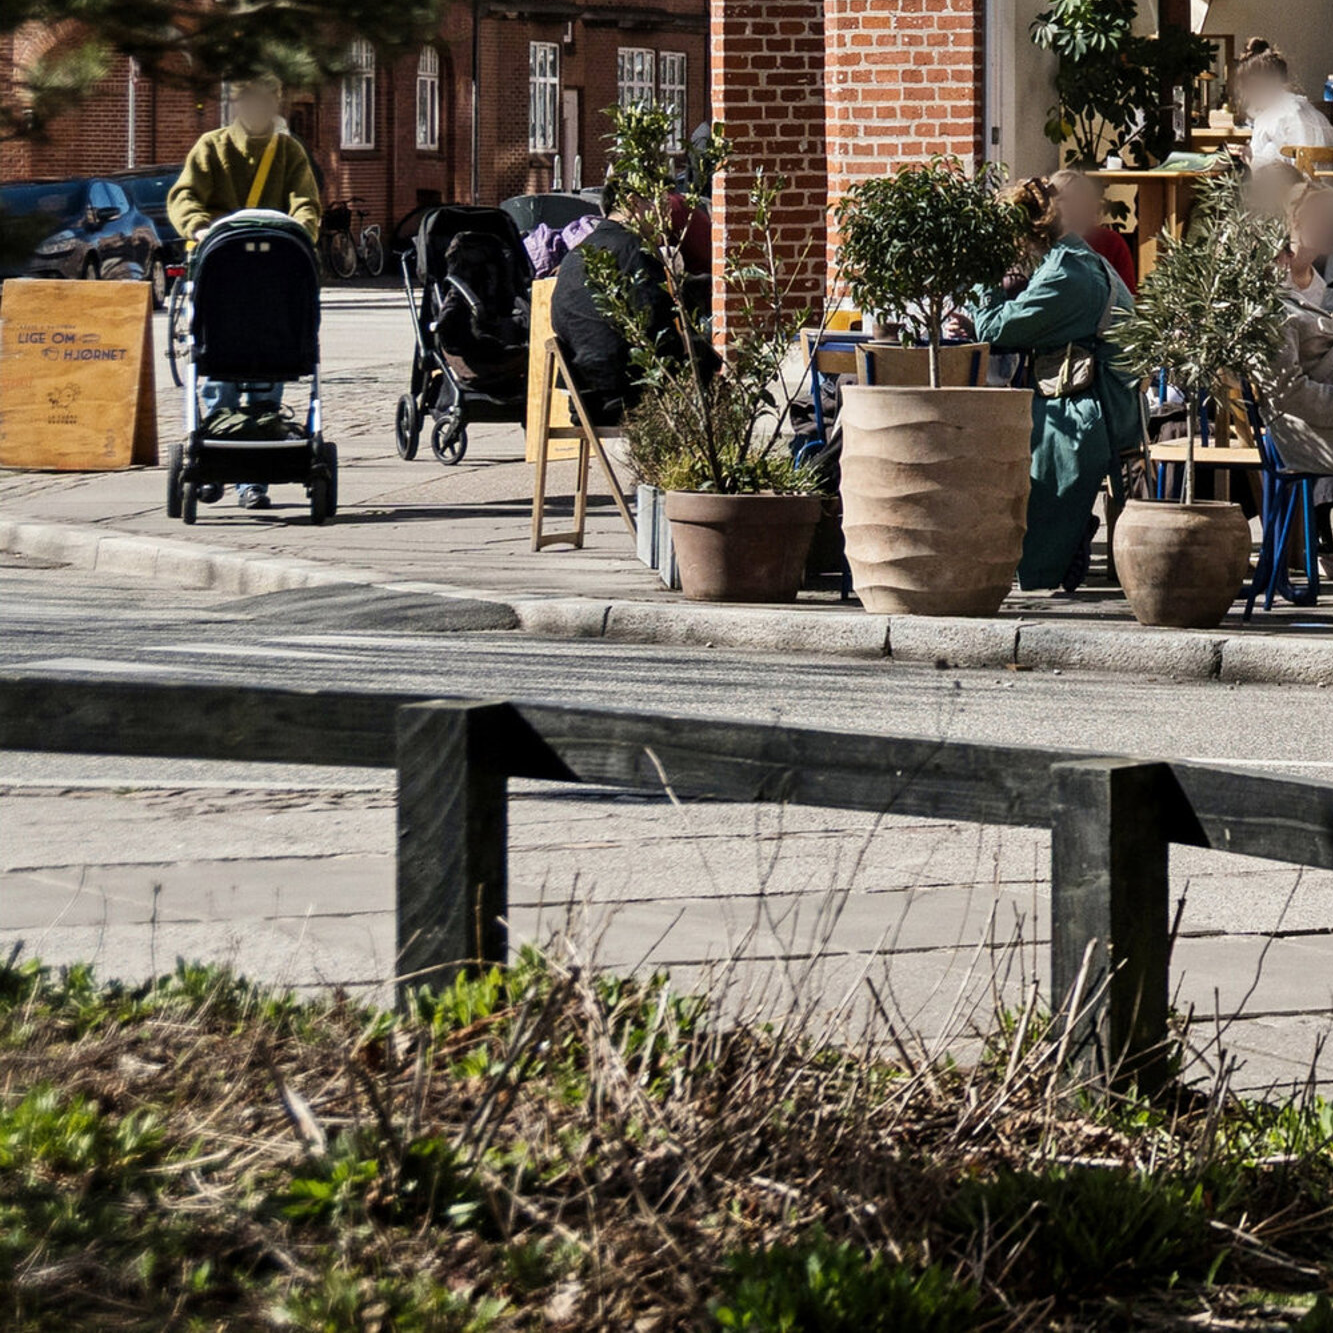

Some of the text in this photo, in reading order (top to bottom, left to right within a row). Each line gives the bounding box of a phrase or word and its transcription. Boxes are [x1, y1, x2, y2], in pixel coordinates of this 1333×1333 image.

[18, 332, 76, 344] LIGE OM
[63, 349, 127, 361] HJØRNET
